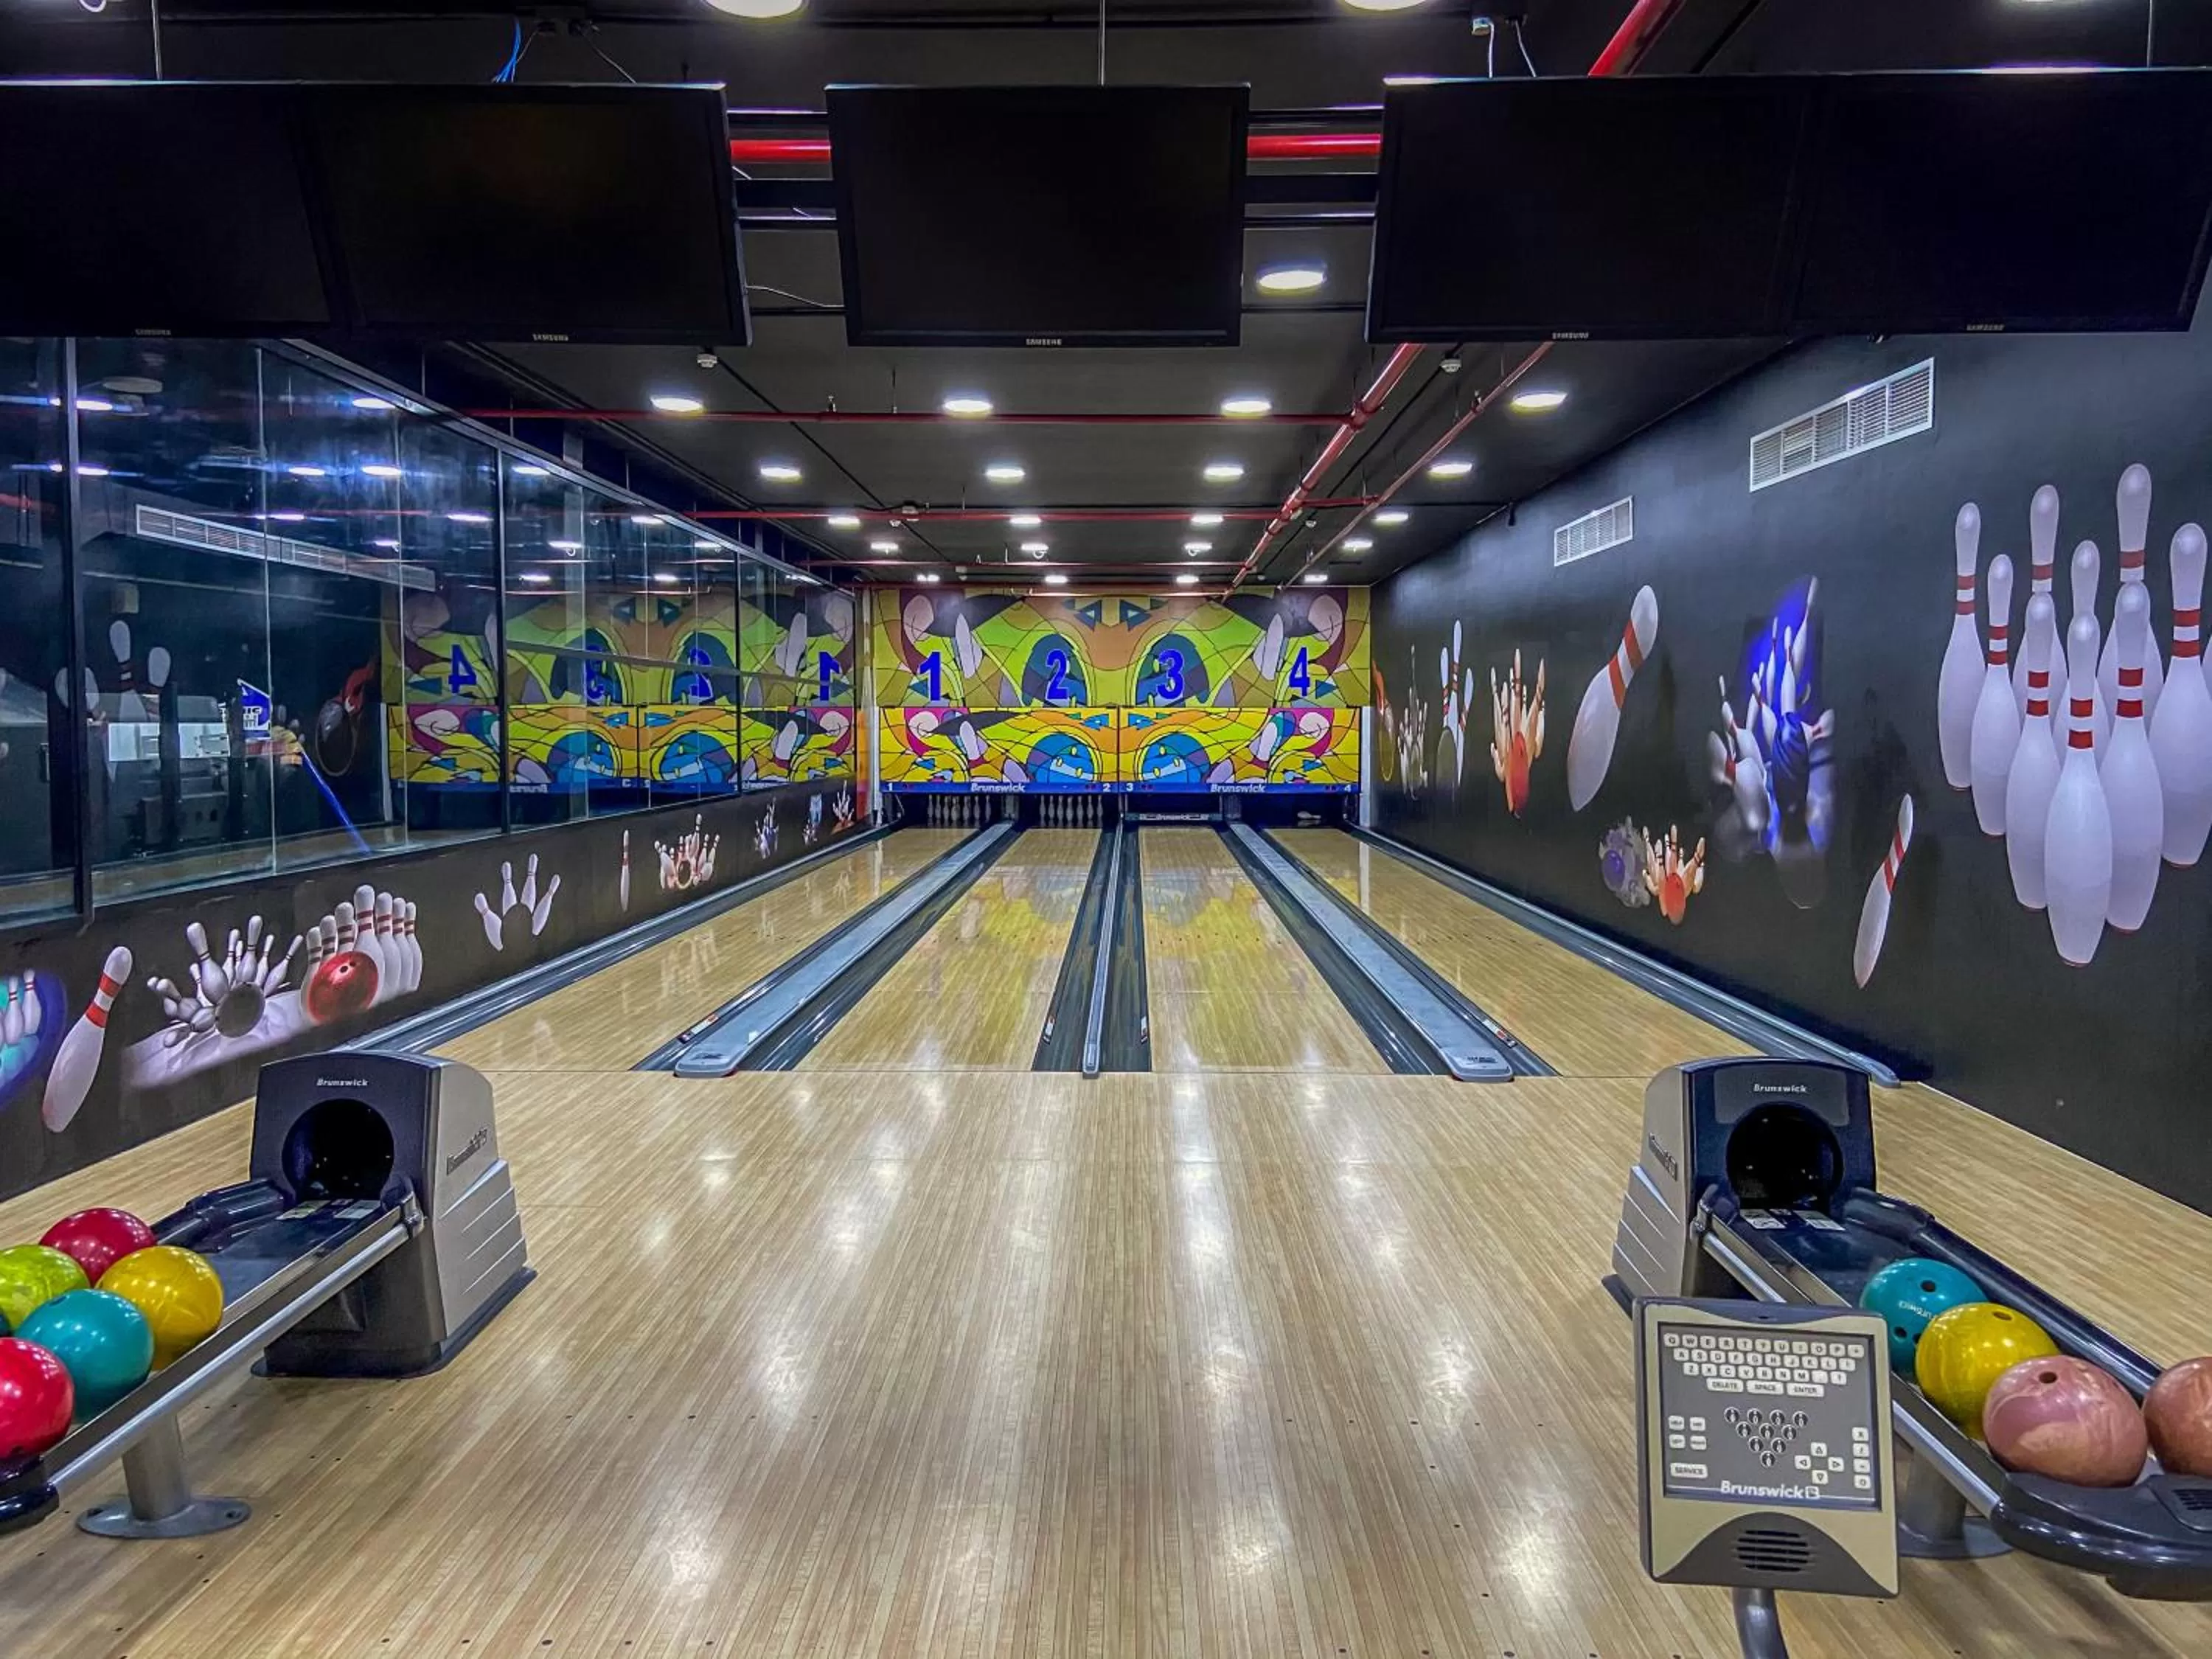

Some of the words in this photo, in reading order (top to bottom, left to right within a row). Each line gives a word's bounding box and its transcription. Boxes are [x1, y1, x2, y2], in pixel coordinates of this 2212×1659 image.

[918, 650, 942, 701] 1
[1046, 648, 1069, 700] 2
[1155, 648, 1184, 700] 3
[1287, 646, 1311, 697] 4
[887, 782, 893, 791] 1
[970, 782, 1026, 793] Brunswick
[1102, 782, 1111, 792] 2
[1126, 782, 1133, 791] 3
[1210, 784, 1266, 793] Brunswick
[1343, 784, 1352, 793] 4
[316, 1078, 369, 1086] Brunswick
[1753, 1083, 1807, 1092] Brunswick
[1720, 1480, 1805, 1499] Brunswick
